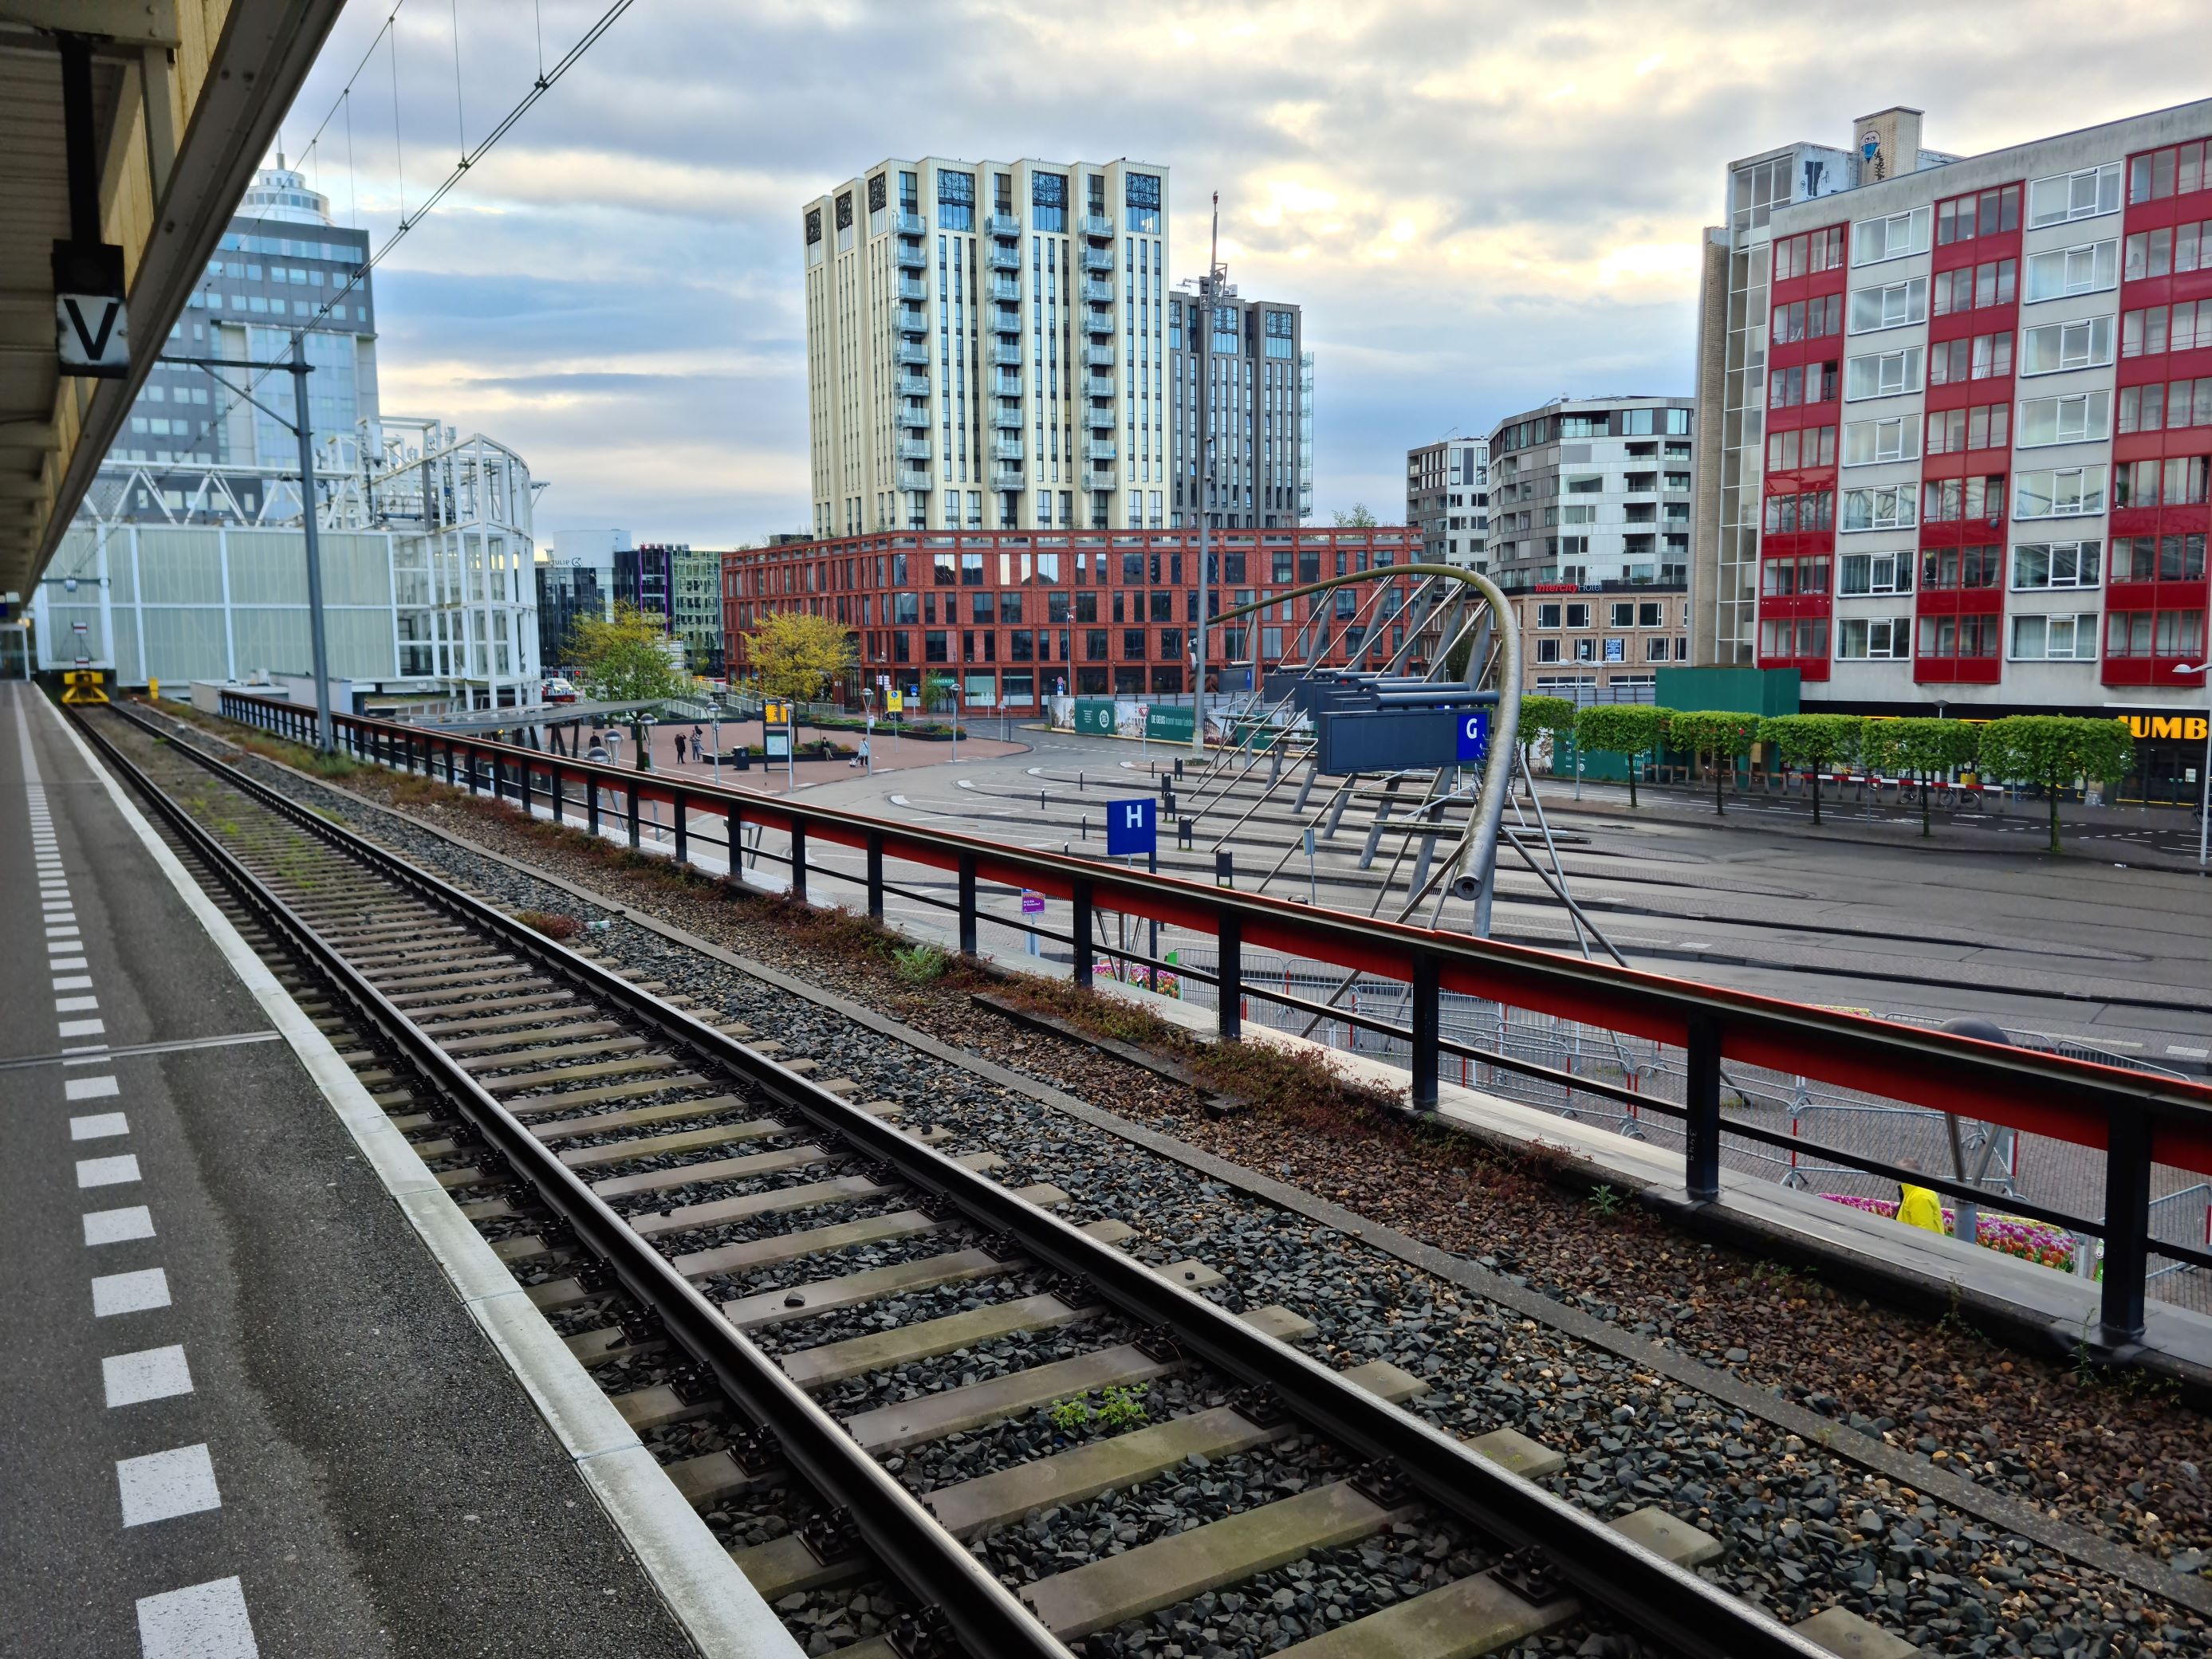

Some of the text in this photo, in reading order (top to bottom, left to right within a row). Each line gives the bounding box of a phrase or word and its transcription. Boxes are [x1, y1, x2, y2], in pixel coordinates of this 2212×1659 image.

[64, 299, 120, 360] V
[1466, 717, 1478, 740] G
[1126, 804, 1143, 828] H
